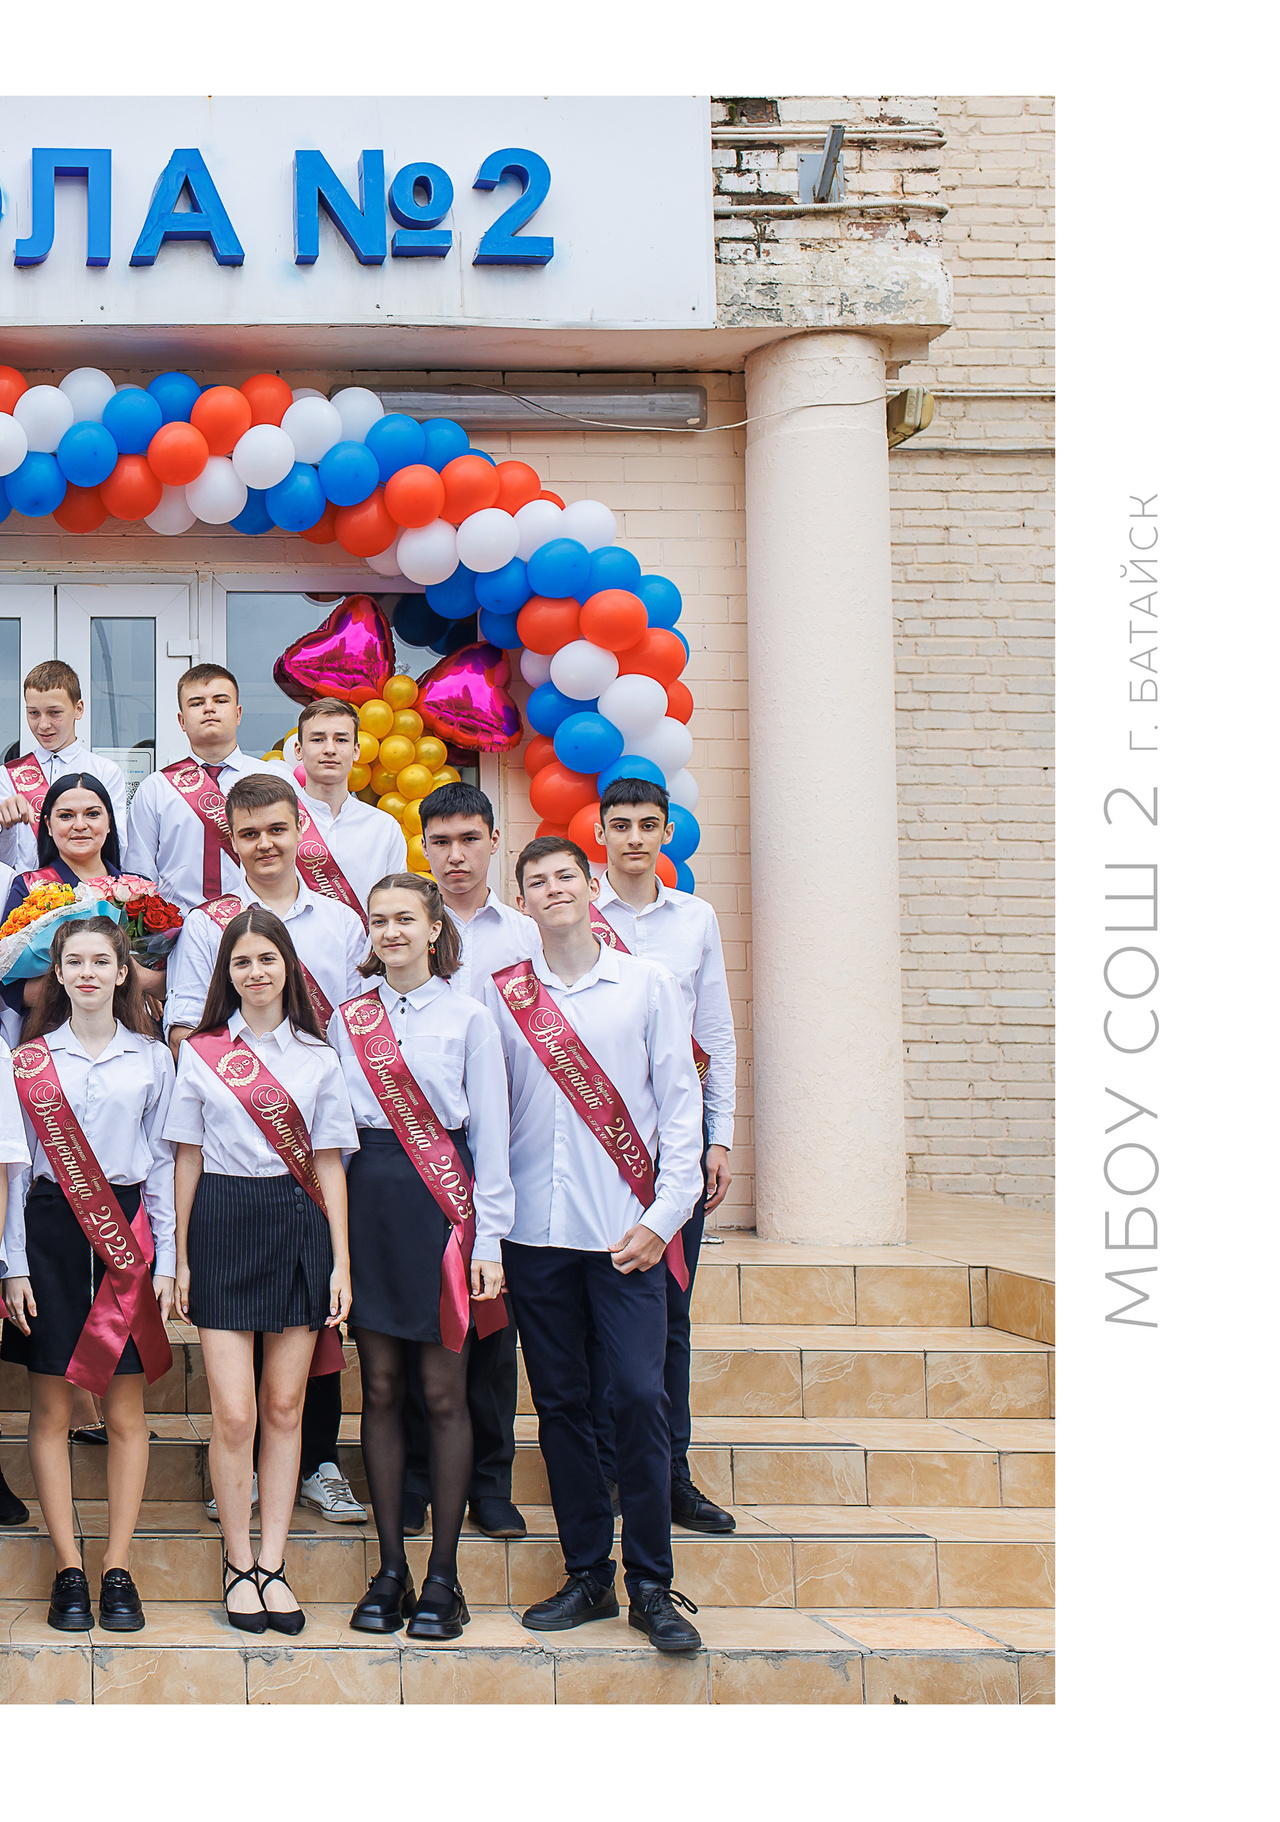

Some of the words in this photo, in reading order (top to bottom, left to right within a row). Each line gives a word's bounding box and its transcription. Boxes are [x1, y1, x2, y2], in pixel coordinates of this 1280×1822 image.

[364, 1035, 430, 1150] Выпускница
[528, 1007, 603, 1110] Выпускник
[28, 1079, 93, 1201] Выпускница
[604, 1117, 647, 1177] 2023
[429, 1155, 478, 1220] 2023
[89, 1205, 134, 1269] 2023
